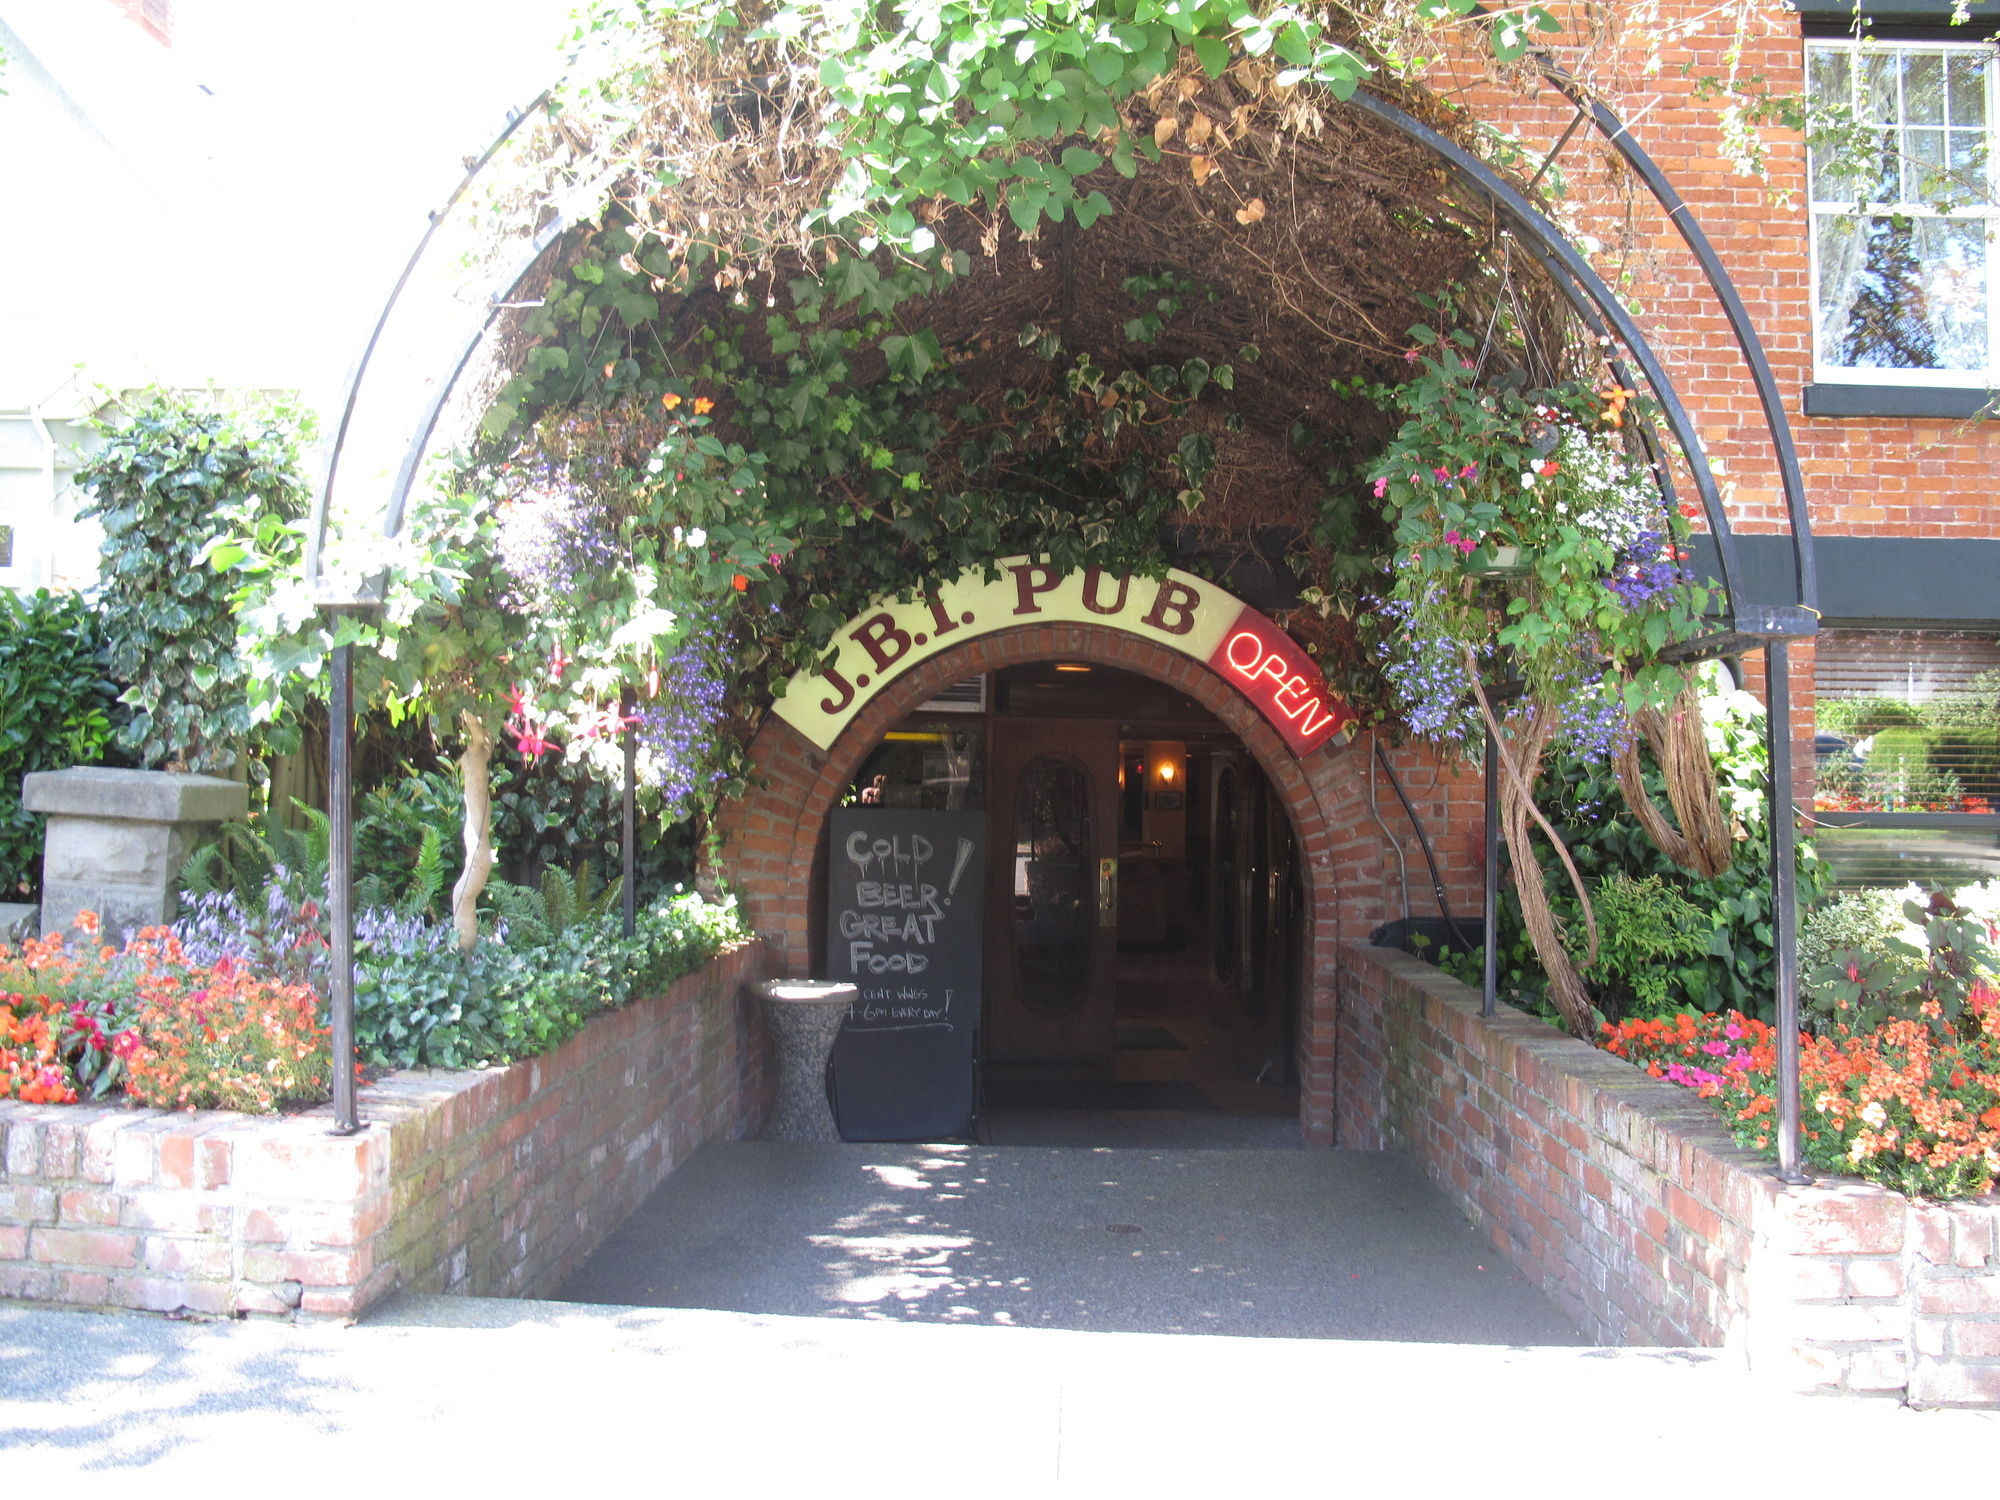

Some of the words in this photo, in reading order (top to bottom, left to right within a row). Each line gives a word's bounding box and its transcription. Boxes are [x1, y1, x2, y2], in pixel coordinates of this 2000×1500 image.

[1008, 562, 1201, 635] PUB
[1226, 631, 1334, 738] OPEN
[846, 830, 934, 872] COLD
[839, 910, 942, 945] GREAT
[850, 941, 929, 975] FOOD
[863, 987, 892, 1000] CENT
